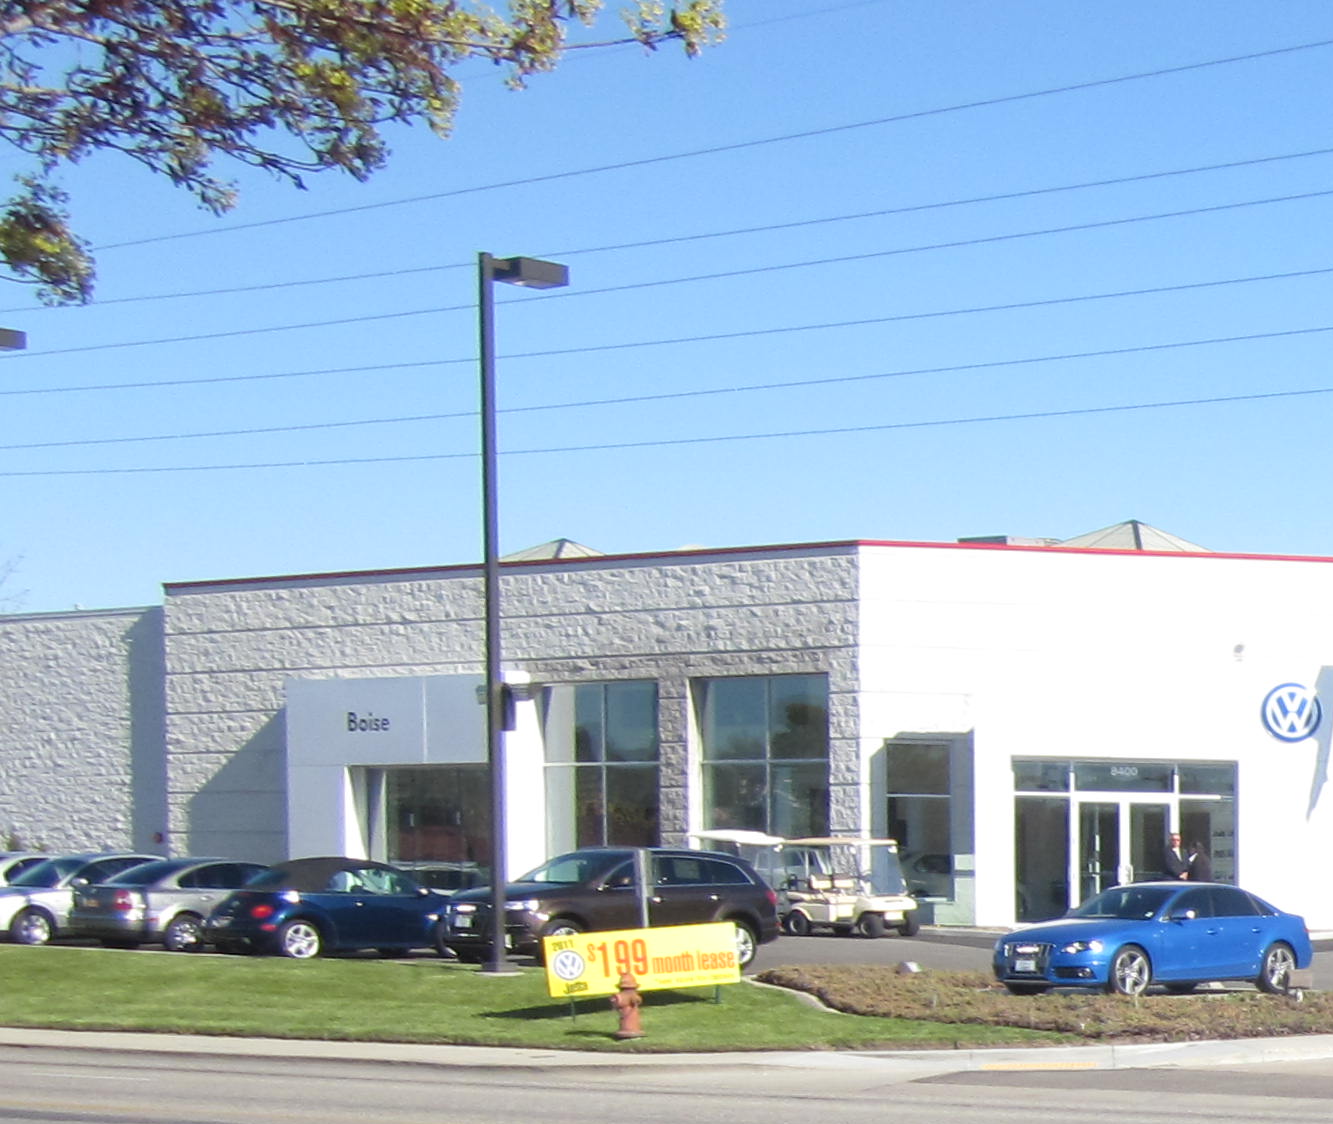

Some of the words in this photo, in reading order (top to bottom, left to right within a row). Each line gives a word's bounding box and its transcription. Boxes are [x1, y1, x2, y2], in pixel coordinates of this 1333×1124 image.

[347, 711, 390, 731] Boise
[587, 939, 648, 977] $199
[653, 953, 695, 974] month
[697, 951, 736, 970] lease
